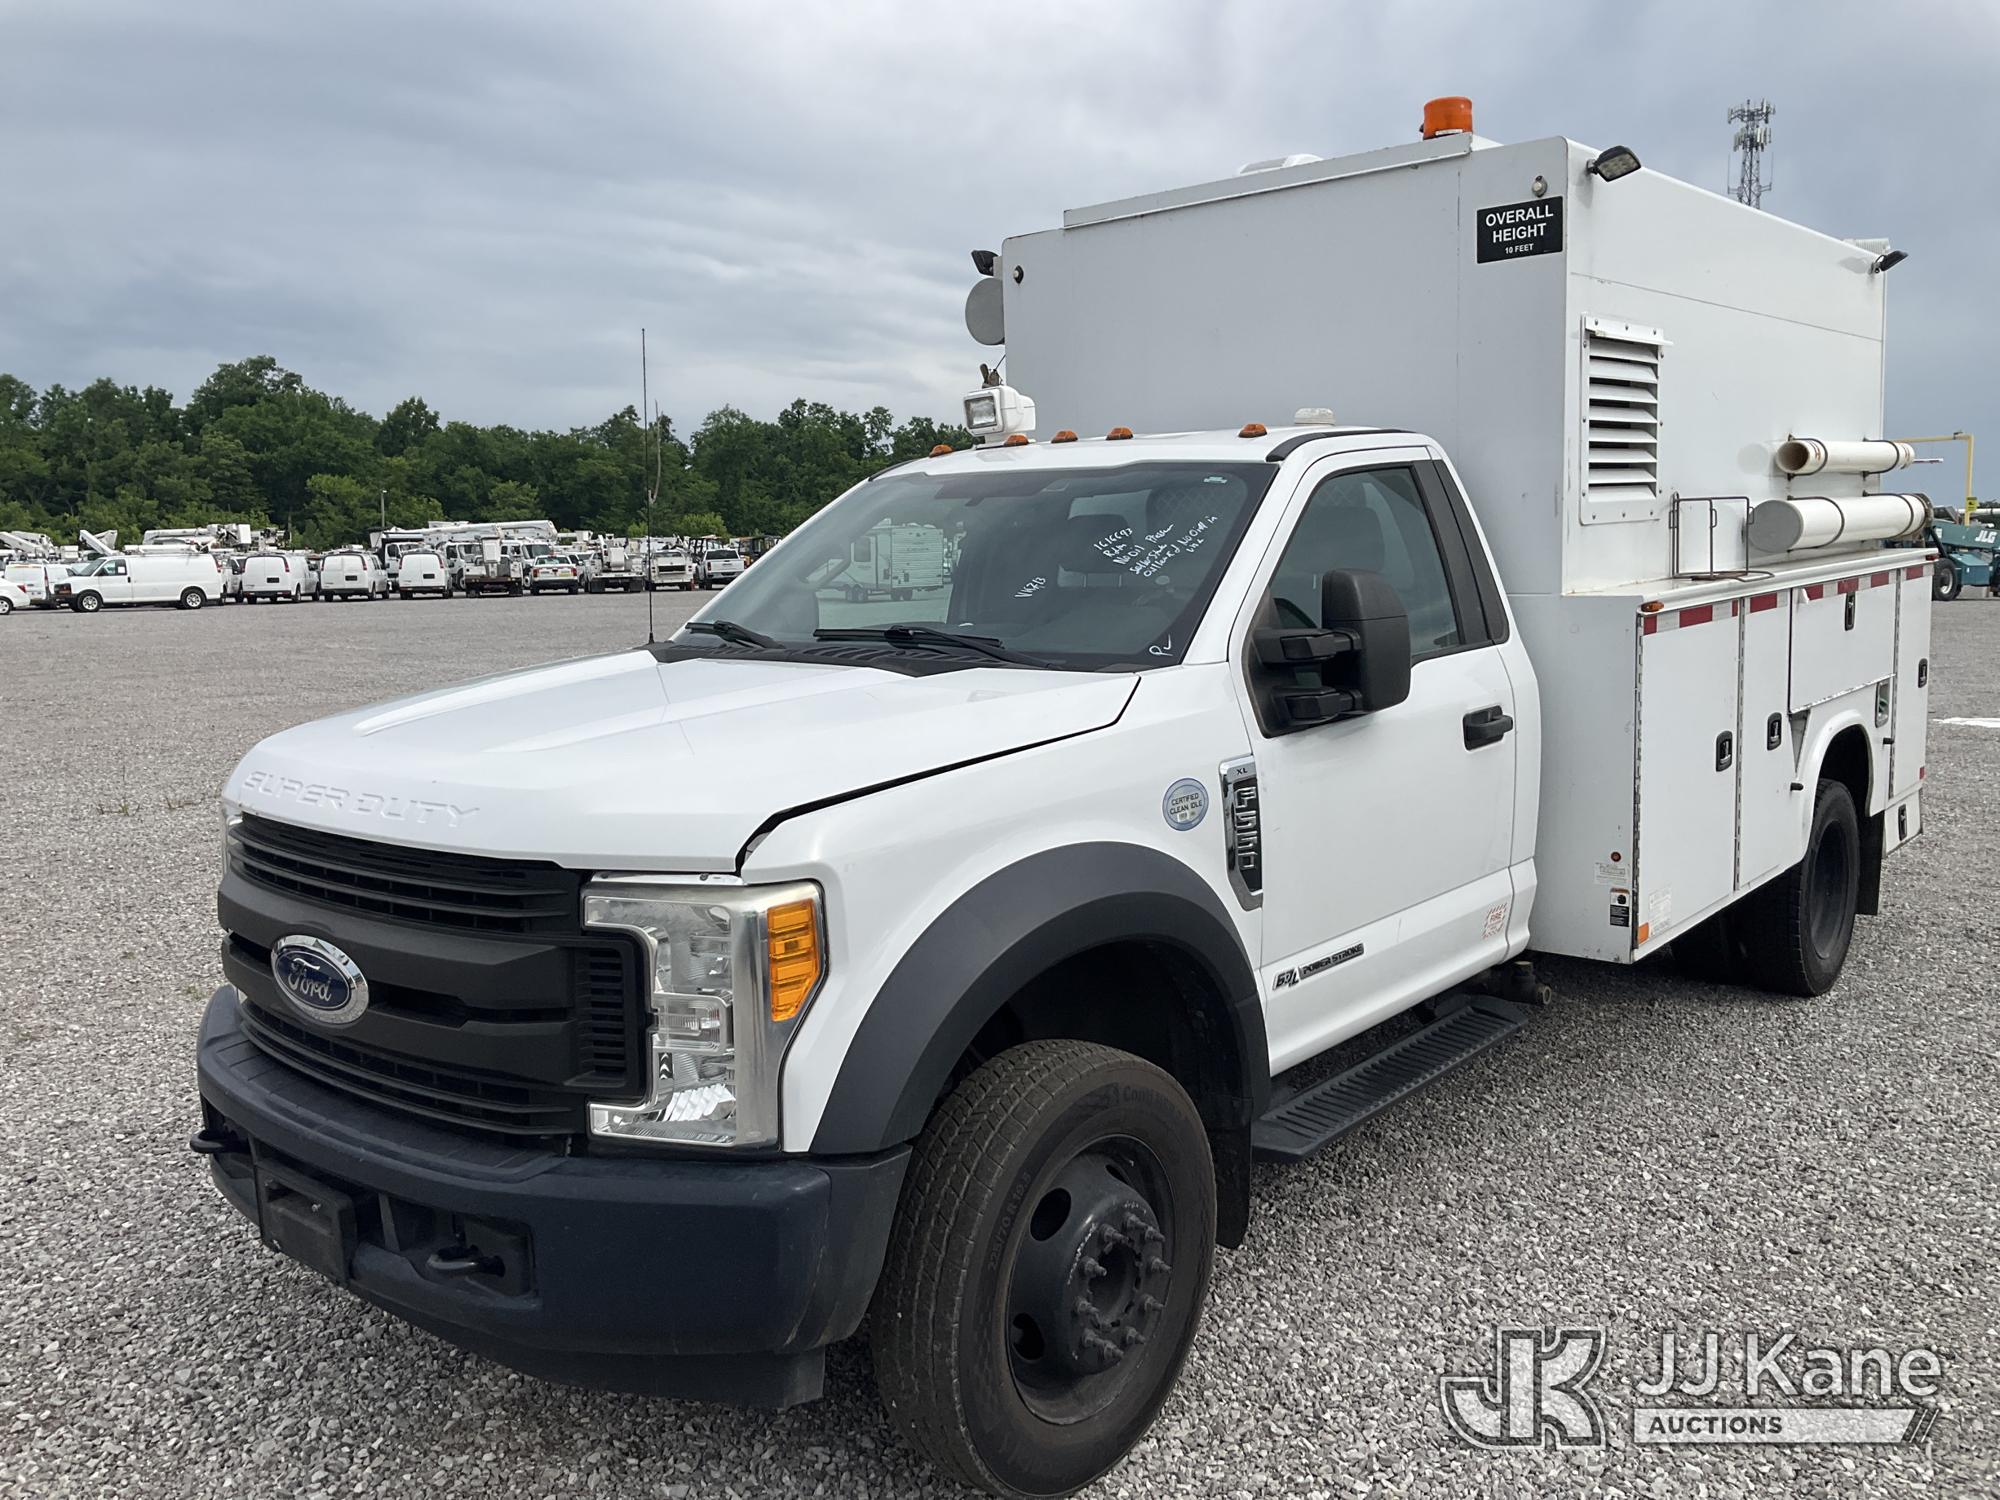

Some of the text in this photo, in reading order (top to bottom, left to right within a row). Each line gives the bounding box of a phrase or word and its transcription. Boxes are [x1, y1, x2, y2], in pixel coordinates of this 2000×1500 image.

[1485, 204, 1554, 227] OVERALL
[1492, 222, 1547, 243] HEIGHT
[1505, 243, 1534, 254] 10 FEET
[1975, 530, 1998, 543] JLG
[1236, 767, 1248, 775] XL
[243, 770, 480, 828] SUPER DUTY
[1169, 799, 1203, 815] CLEAN IDLE
[1171, 792, 1199, 806] CERTIFIED
[1302, 956, 1331, 975] POWER
[1331, 943, 1364, 964] STROKE
[288, 957, 332, 1001] Ford
